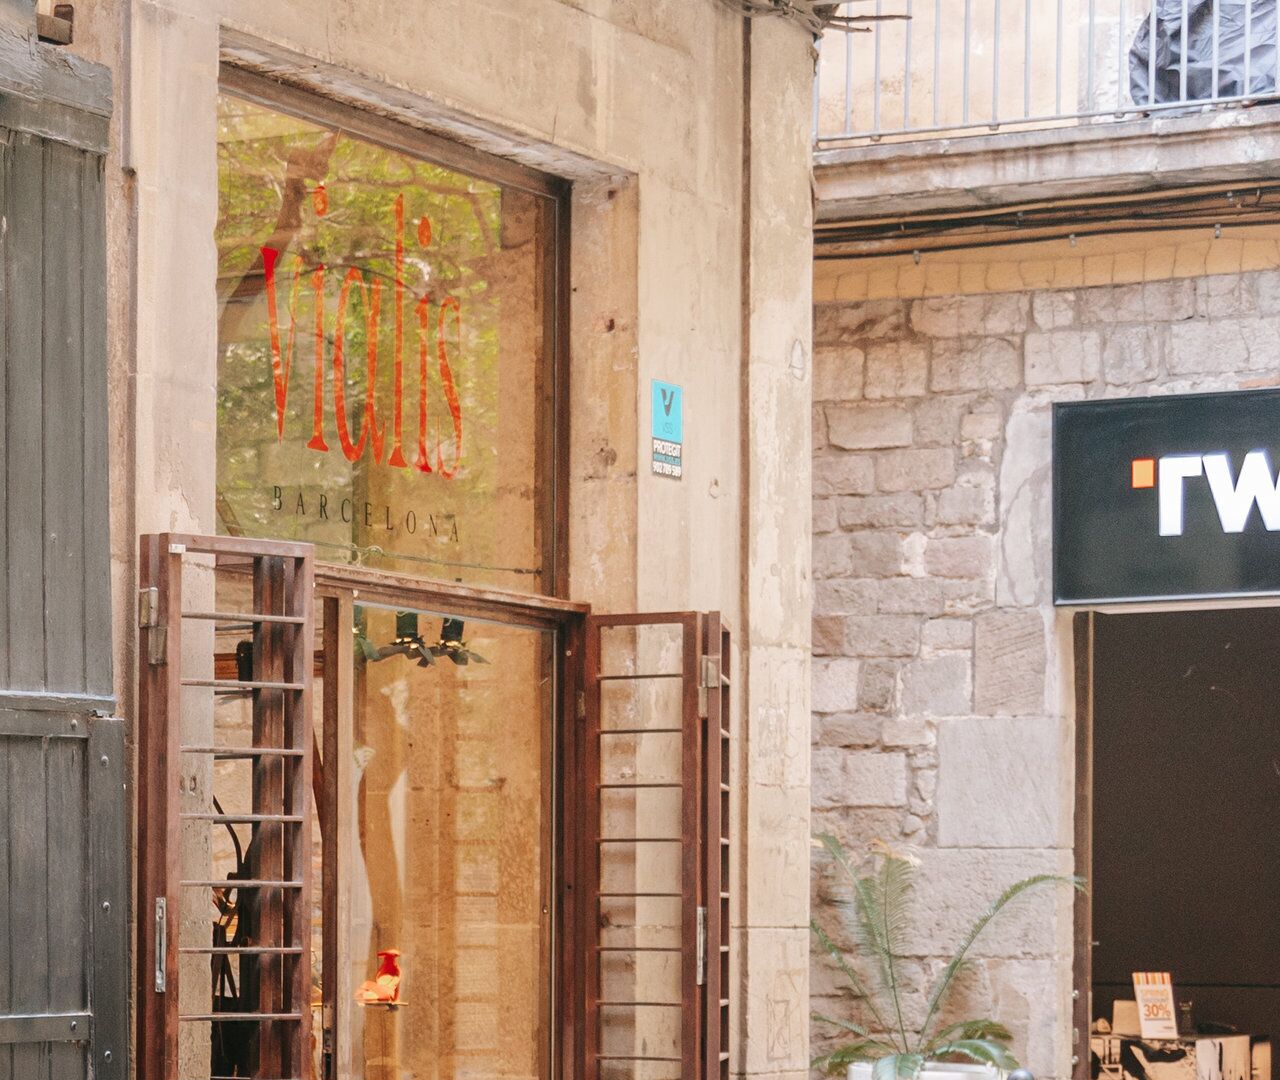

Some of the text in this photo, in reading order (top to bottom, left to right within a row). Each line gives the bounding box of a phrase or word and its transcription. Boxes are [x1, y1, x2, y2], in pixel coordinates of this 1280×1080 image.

[260, 186, 463, 480] Vialis
[273, 486, 459, 542] BARCELONA
[1144, 1003, 1172, 1018] 30%
